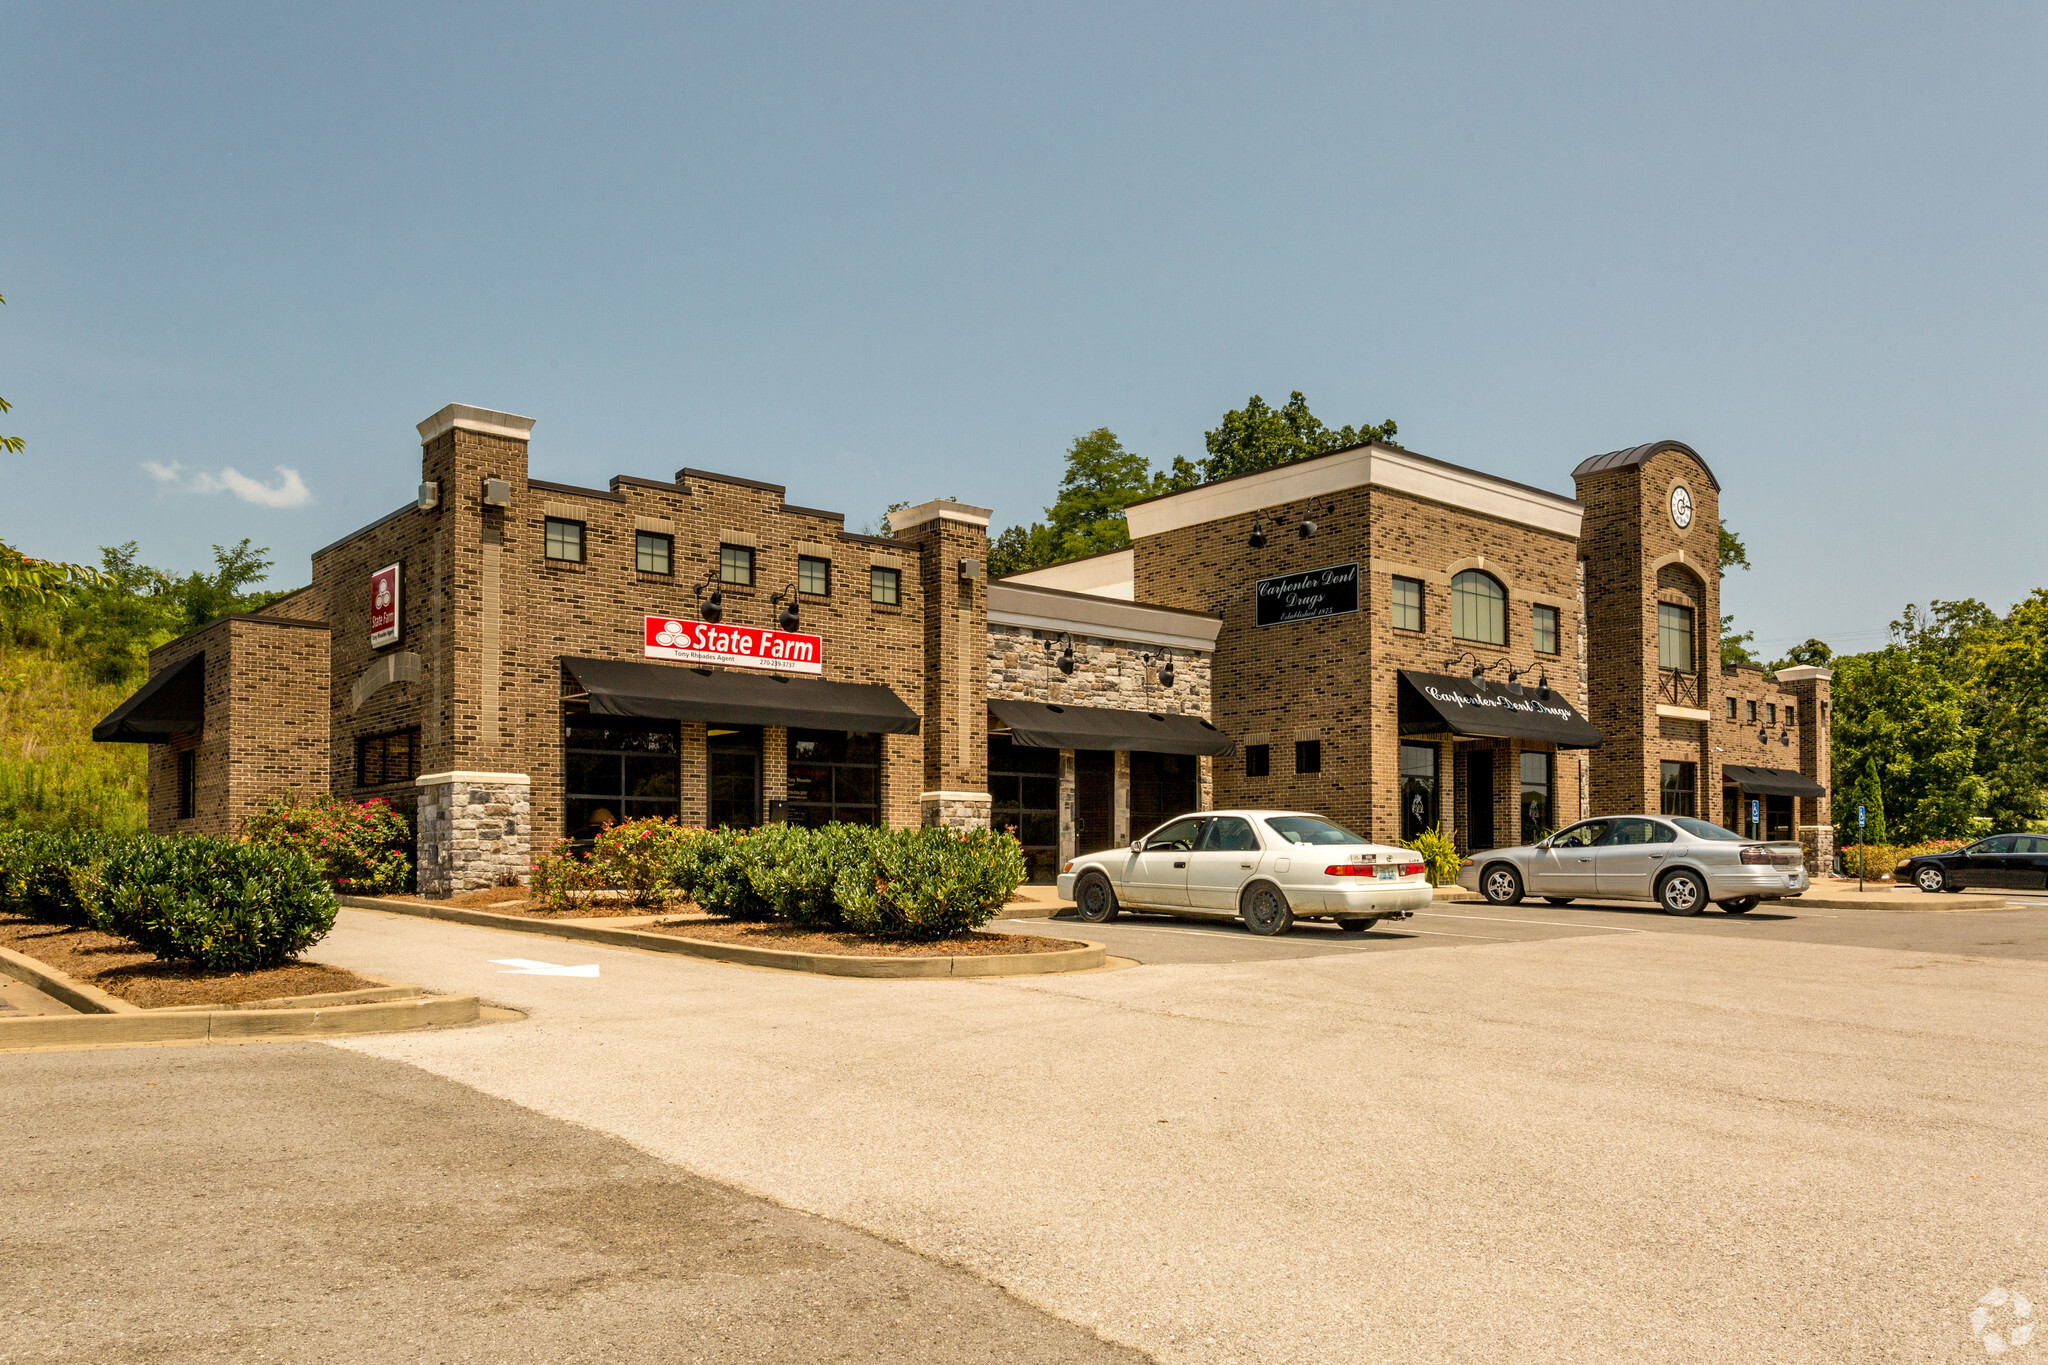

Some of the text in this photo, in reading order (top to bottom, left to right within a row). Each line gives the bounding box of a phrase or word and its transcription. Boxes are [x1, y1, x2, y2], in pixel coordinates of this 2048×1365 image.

[1258, 567, 1356, 599] Carpenter Dent
[1286, 592, 1326, 609] Drugs
[372, 612, 393, 628] State Farm
[1280, 608, 1316, 620] Established
[693, 625, 813, 661] State Farm
[674, 650, 690, 658] Tony
[690, 651, 716, 660] Rhoades
[1532, 701, 1571, 720] Drugs
